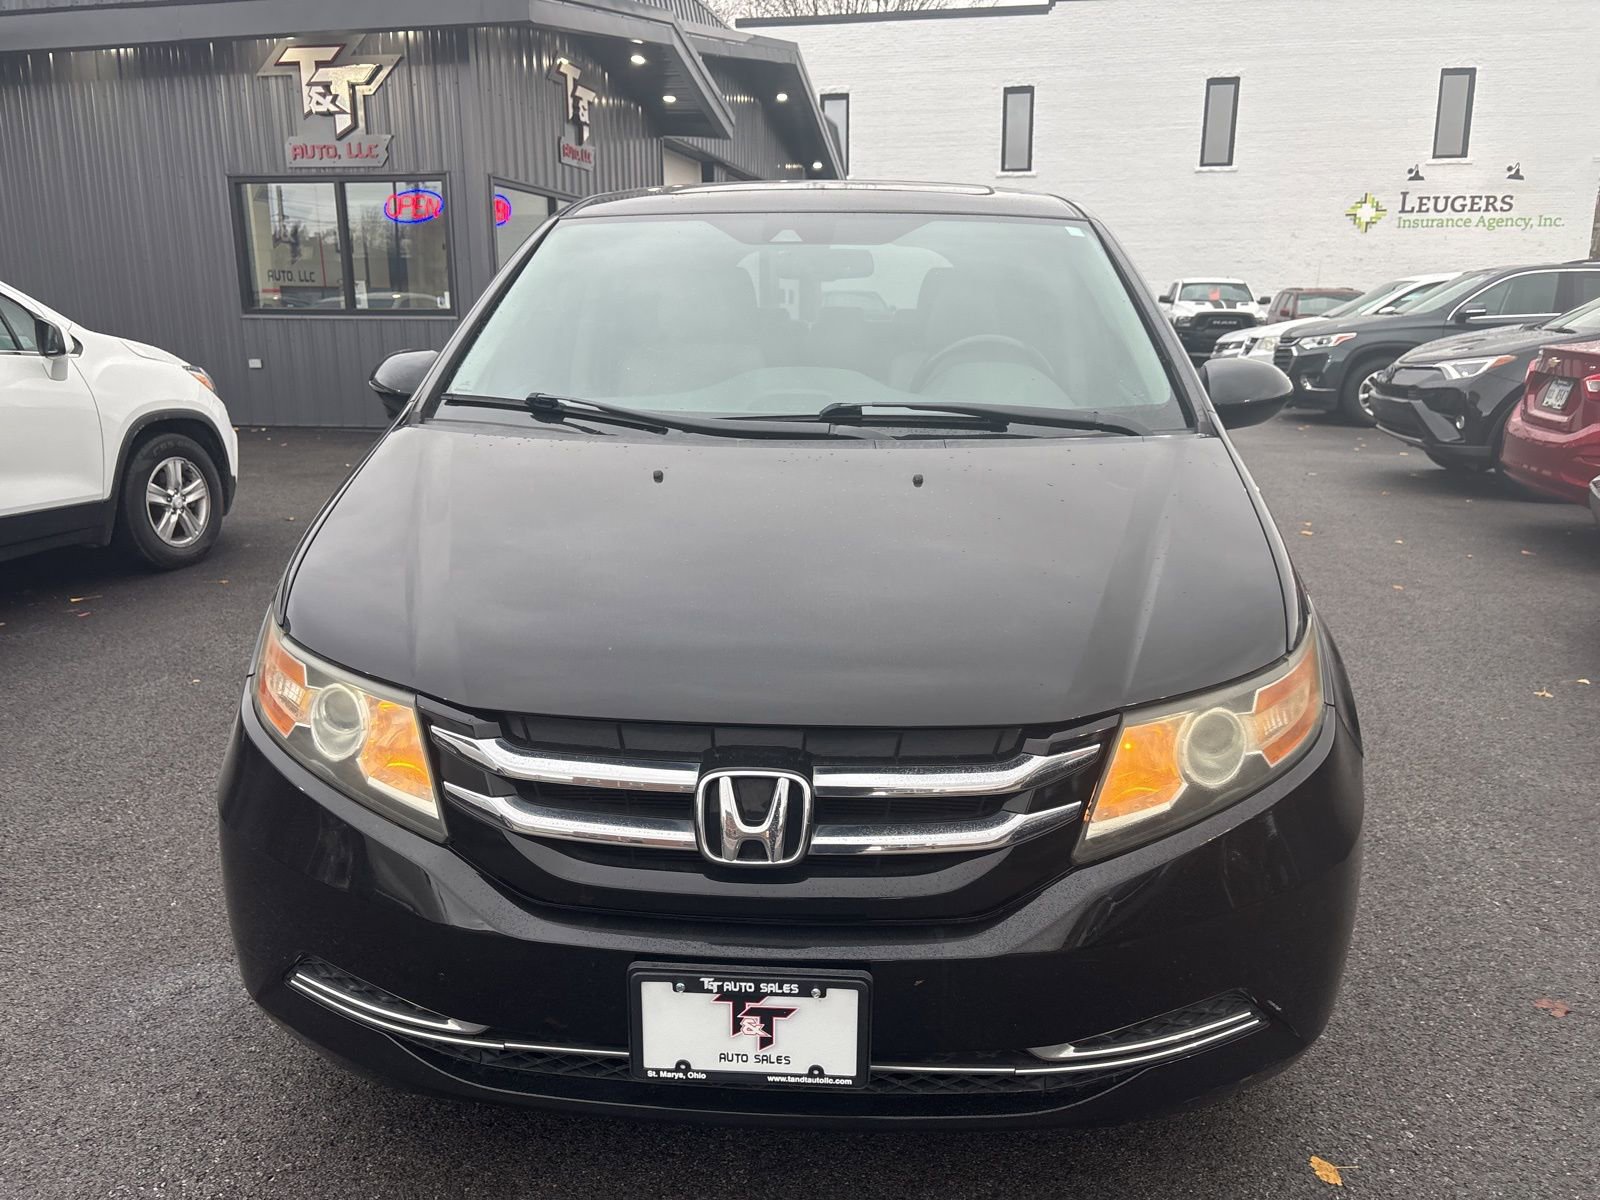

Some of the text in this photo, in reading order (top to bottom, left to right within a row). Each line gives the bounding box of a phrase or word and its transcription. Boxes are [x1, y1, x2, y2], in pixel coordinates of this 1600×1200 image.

[346, 142, 379, 159] LLC
[386, 194, 442, 219] OPEN
[1398, 191, 1515, 214] LEUGERS
[1397, 214, 1565, 231] Insurance Agency, Inc.
[299, 271, 316, 283] LLC
[723, 981, 755, 993] AUTO
[760, 983, 799, 994] SALES
[719, 1052, 791, 1065] AUTO SALES
[647, 1070, 658, 1078] St.
[687, 1071, 707, 1079] Ohio
